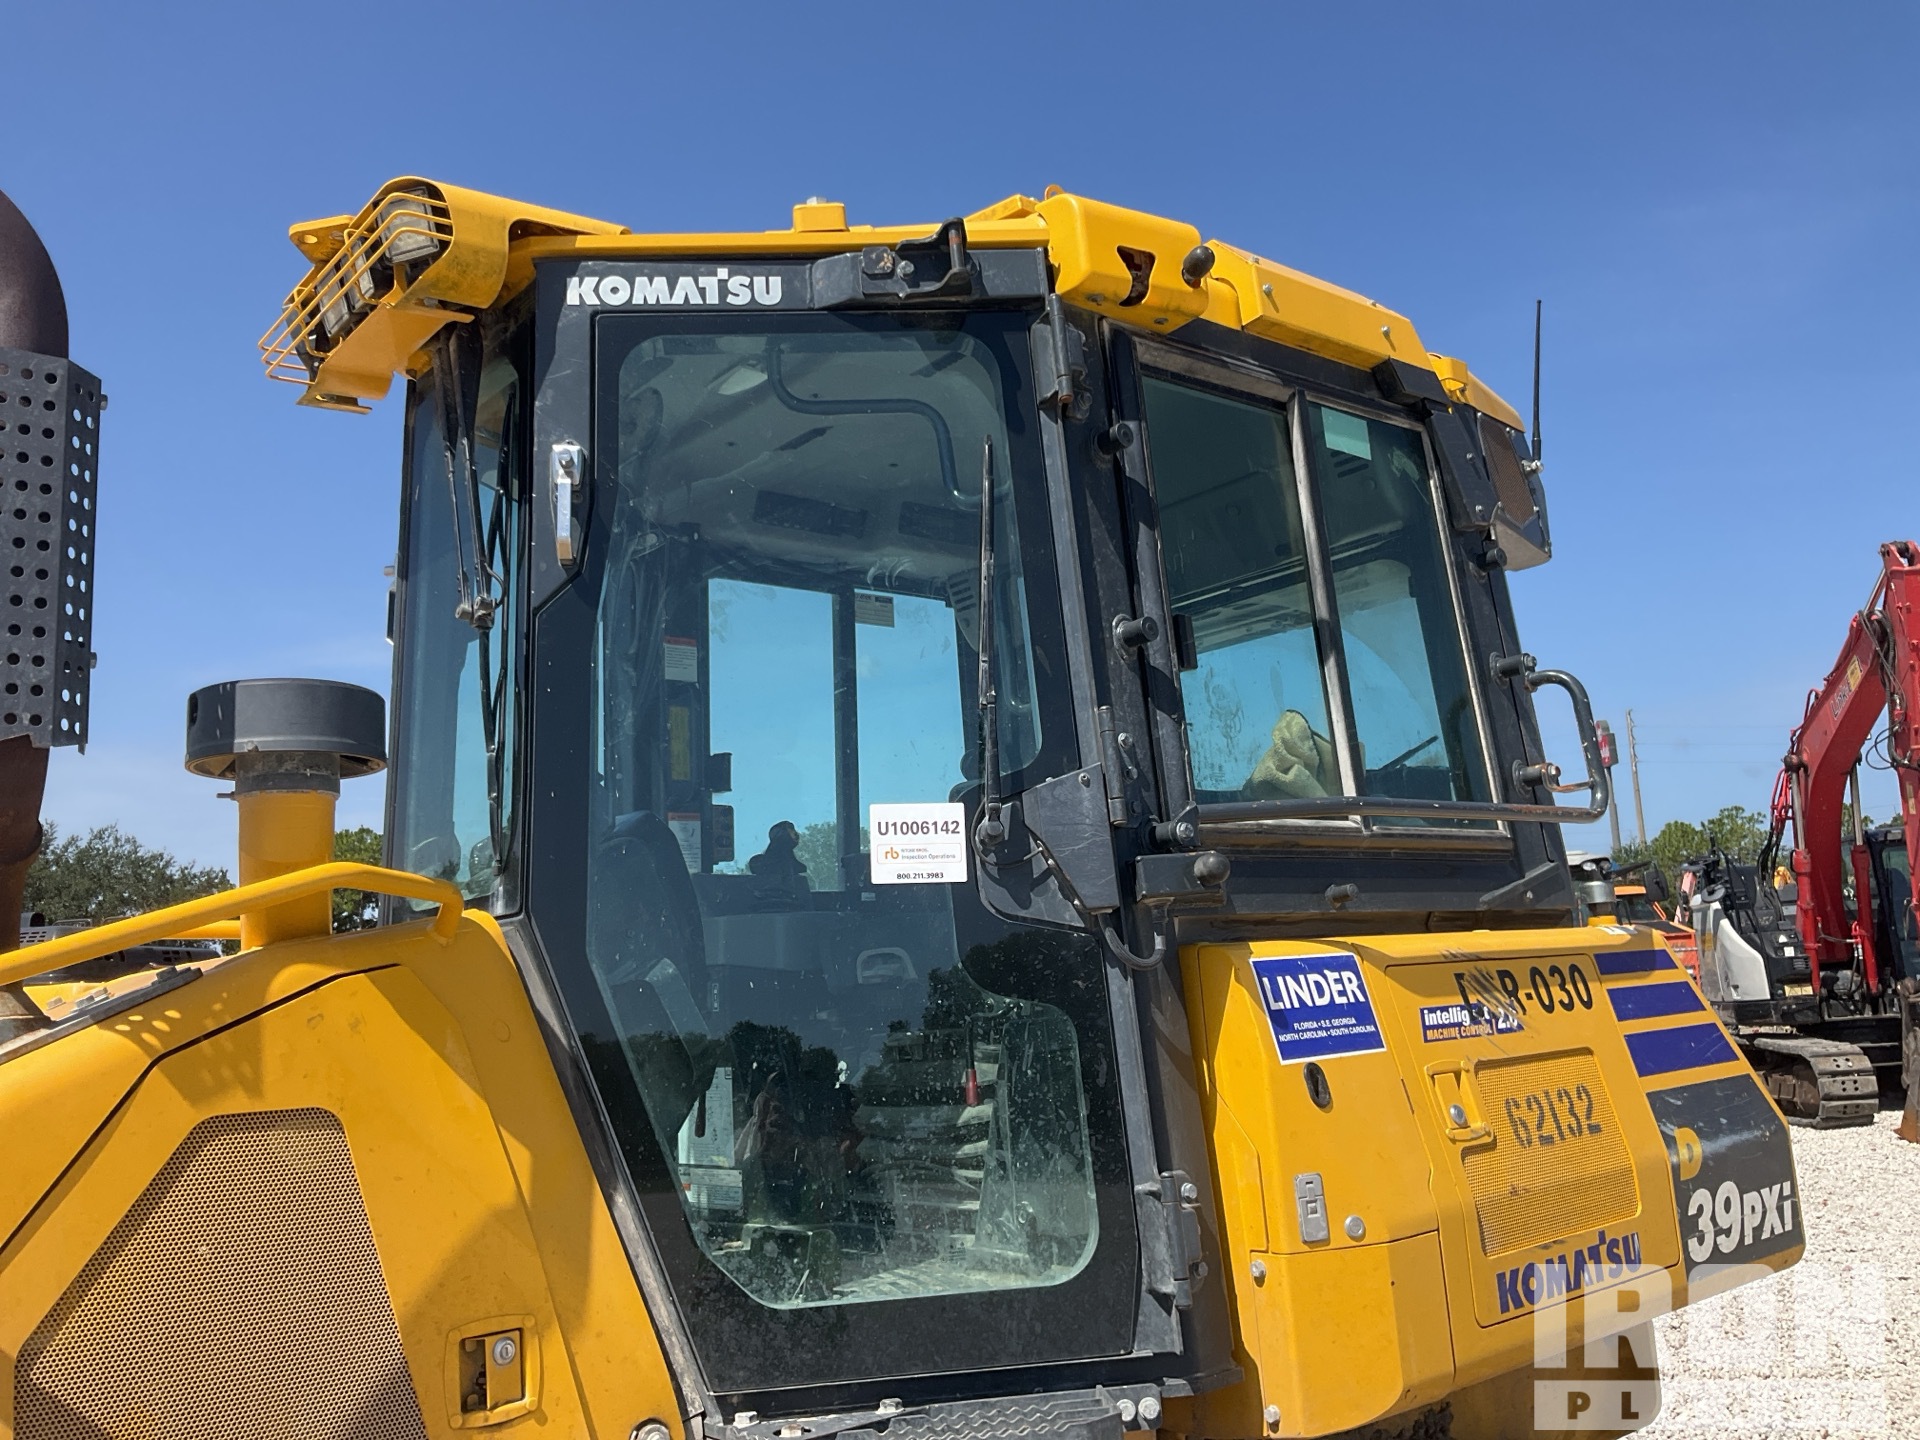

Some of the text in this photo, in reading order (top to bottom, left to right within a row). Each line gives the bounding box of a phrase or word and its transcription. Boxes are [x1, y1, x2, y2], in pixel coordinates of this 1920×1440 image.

[566, 268, 782, 306] KOMATSU
[877, 820, 960, 836] U1006142
[896, 872, 944, 880] 800.211.3983
[1262, 969, 1366, 1010] LINDER
[1278, 1024, 1376, 1042] NORTH CAROLINA SOUTH CAROLINA
[1293, 1021, 1318, 1031] FLORIDA
[1331, 1016, 1357, 1027] GEORGIA
[1426, 1027, 1459, 1041] MACHINE
[1504, 1083, 1603, 1148] 62132
[1673, 1127, 1703, 1182] D
[1496, 1229, 1642, 1315] KOMATSU
